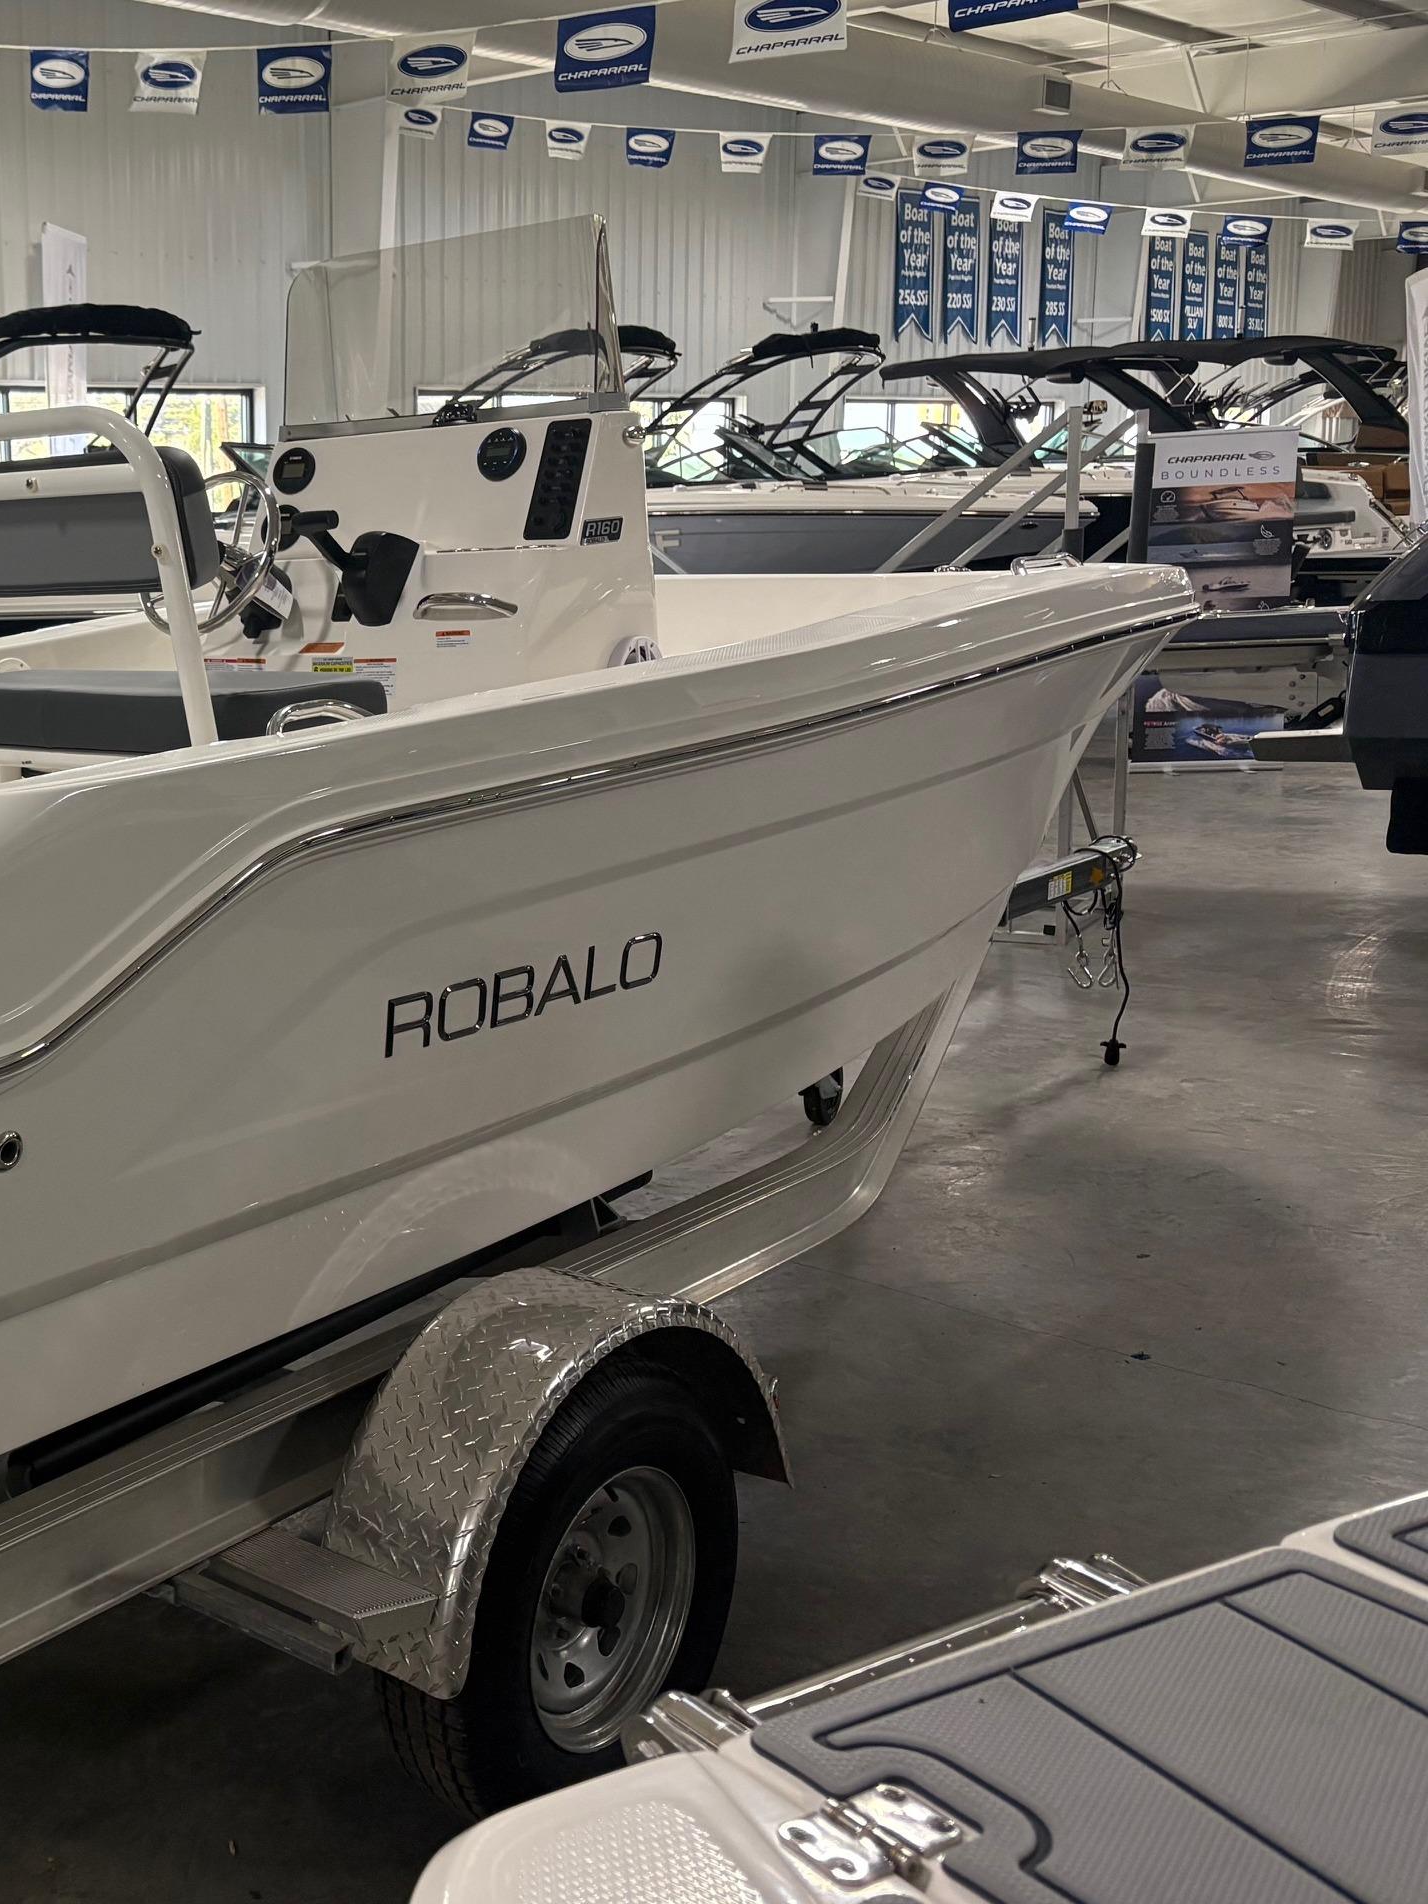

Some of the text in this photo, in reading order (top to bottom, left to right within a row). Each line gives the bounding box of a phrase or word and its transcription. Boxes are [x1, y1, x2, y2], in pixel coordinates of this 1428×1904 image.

[736, 33, 844, 55] CHAPARRAL
[558, 63, 647, 81] CHAPARRAL
[391, 82, 466, 96] CHAPARRAL
[259, 93, 327, 104] CHAPARRAL
[1246, 150, 1314, 160] CHAPARRAL
[1018, 160, 1075, 168] CHAPARRAL
[905, 203, 928, 222] Boat
[996, 218, 1018, 233] Boat
[900, 226, 930, 245] of the
[947, 233, 976, 250] of the
[992, 237, 1020, 254] of the
[1045, 244, 1070, 261] of the
[1155, 237, 1172, 252] Boat
[1188, 243, 1204, 258] Boat
[904, 249, 928, 268] Year
[1220, 246, 1236, 262] Boat
[1251, 250, 1266, 266] Boat
[950, 254, 973, 272] Year
[995, 258, 1017, 275] Year
[1151, 255, 1173, 271] of the
[1185, 261, 1206, 276] of the
[1047, 265, 1067, 281] Year
[1217, 264, 1237, 280] of the
[1247, 268, 1266, 283] of the
[1153, 274, 1170, 290] Year
[1187, 279, 1203, 294] Year
[1219, 283, 1234, 297] Year
[1249, 286, 1263, 300] Year
[1167, 453, 1247, 464] CHAPARRAL
[1161, 466, 1281, 480] BOUNDLESS
[585, 521, 620, 537] R160
[385, 932, 663, 1058] ROBALO
